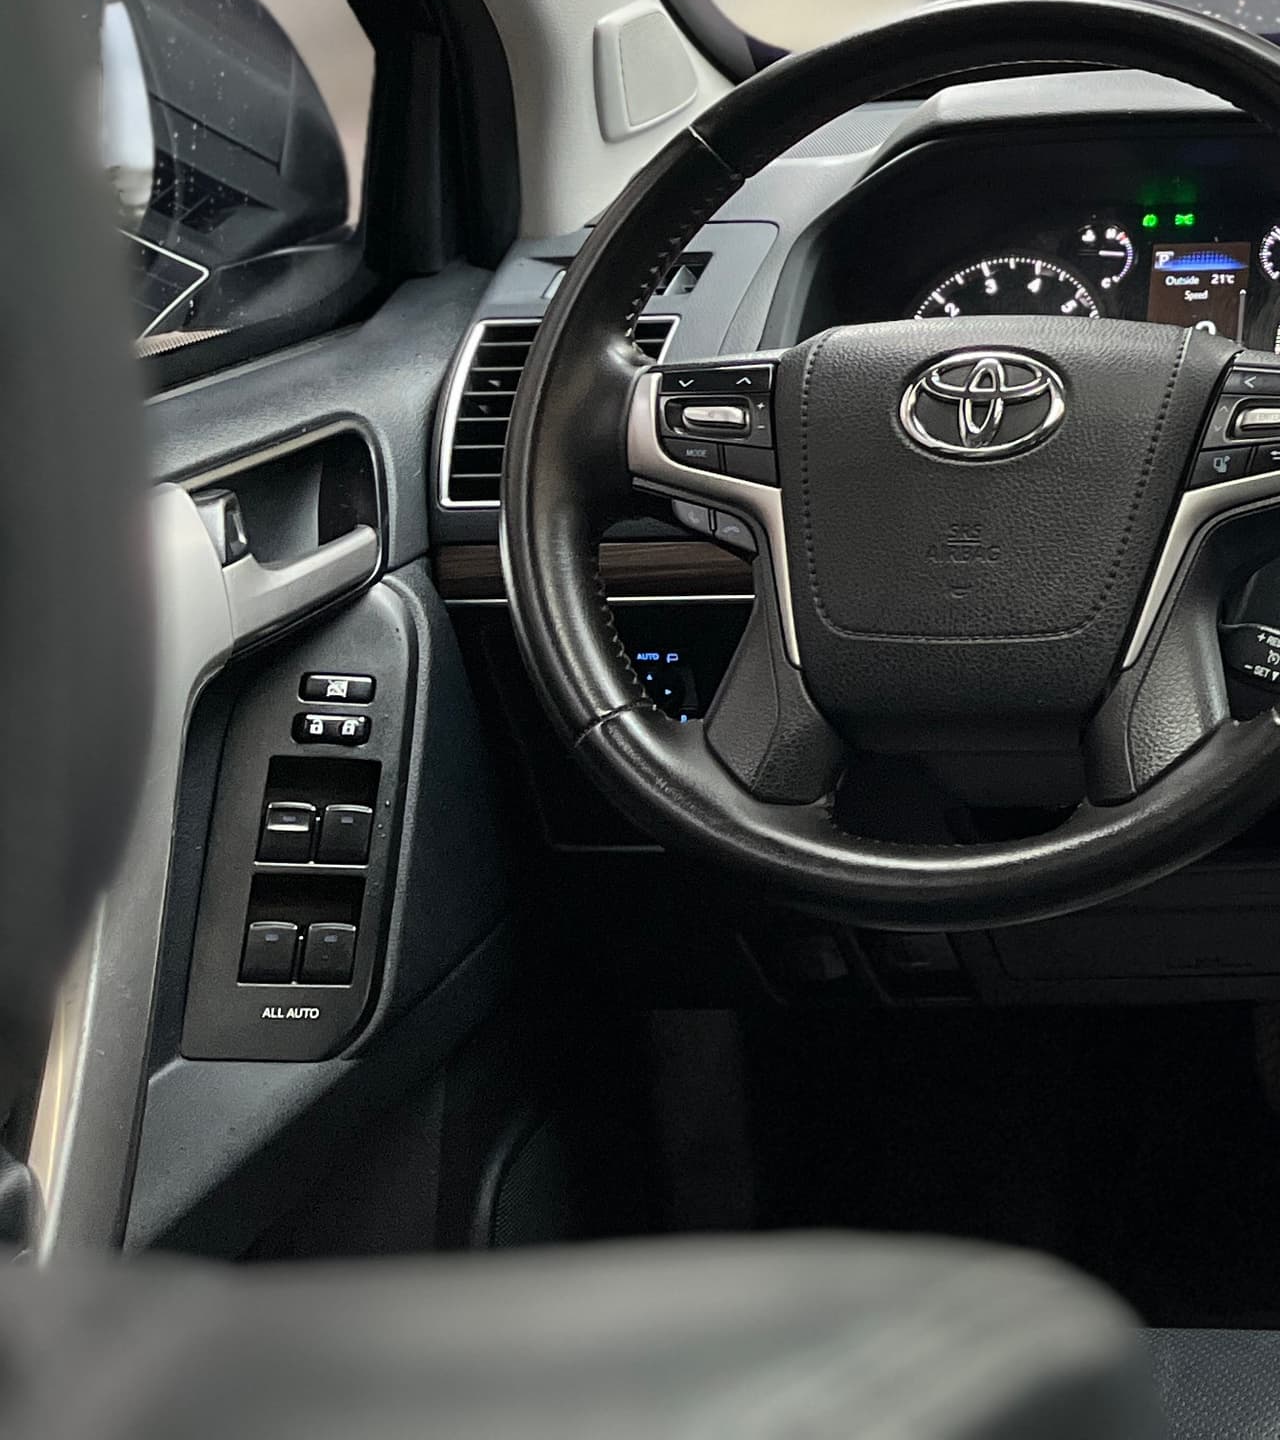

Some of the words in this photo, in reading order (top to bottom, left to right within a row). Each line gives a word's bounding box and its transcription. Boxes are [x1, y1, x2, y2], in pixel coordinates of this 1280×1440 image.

[984, 278, 998, 295] 3
[1026, 278, 1042, 293] 4
[1165, 275, 1200, 286] Outside
[1184, 290, 1209, 301] Speed
[944, 302, 961, 317] 2
[1061, 299, 1078, 314] 5
[686, 449, 707, 457] MODE
[261, 1007, 284, 1018] ALL
[286, 1007, 320, 1019] AUTO
